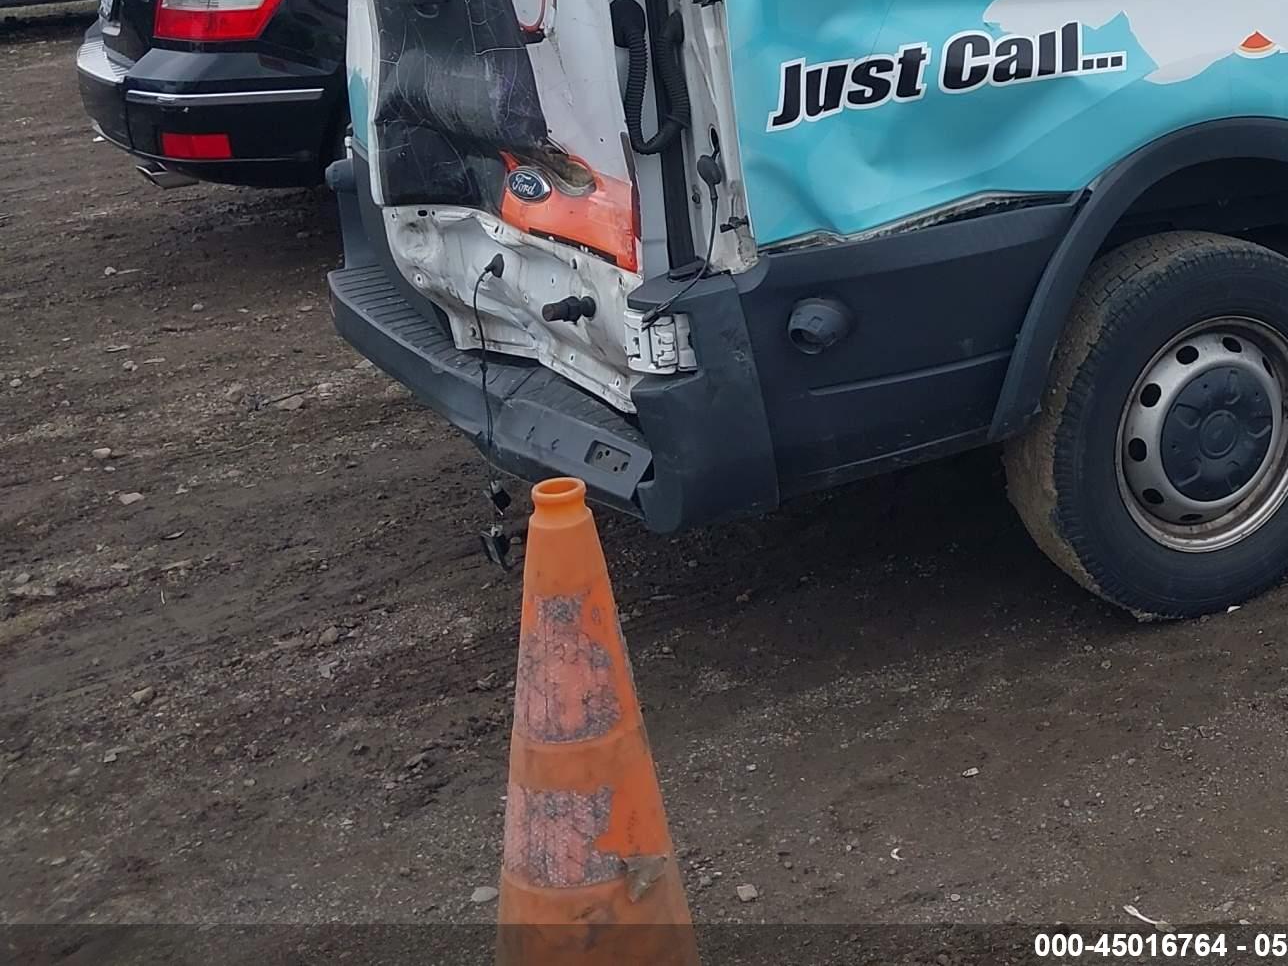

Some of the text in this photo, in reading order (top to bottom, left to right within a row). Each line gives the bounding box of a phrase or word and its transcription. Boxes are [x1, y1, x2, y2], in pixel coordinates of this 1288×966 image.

[767, 22, 1126, 131] Just Call...
[511, 174, 536, 196] Ford
